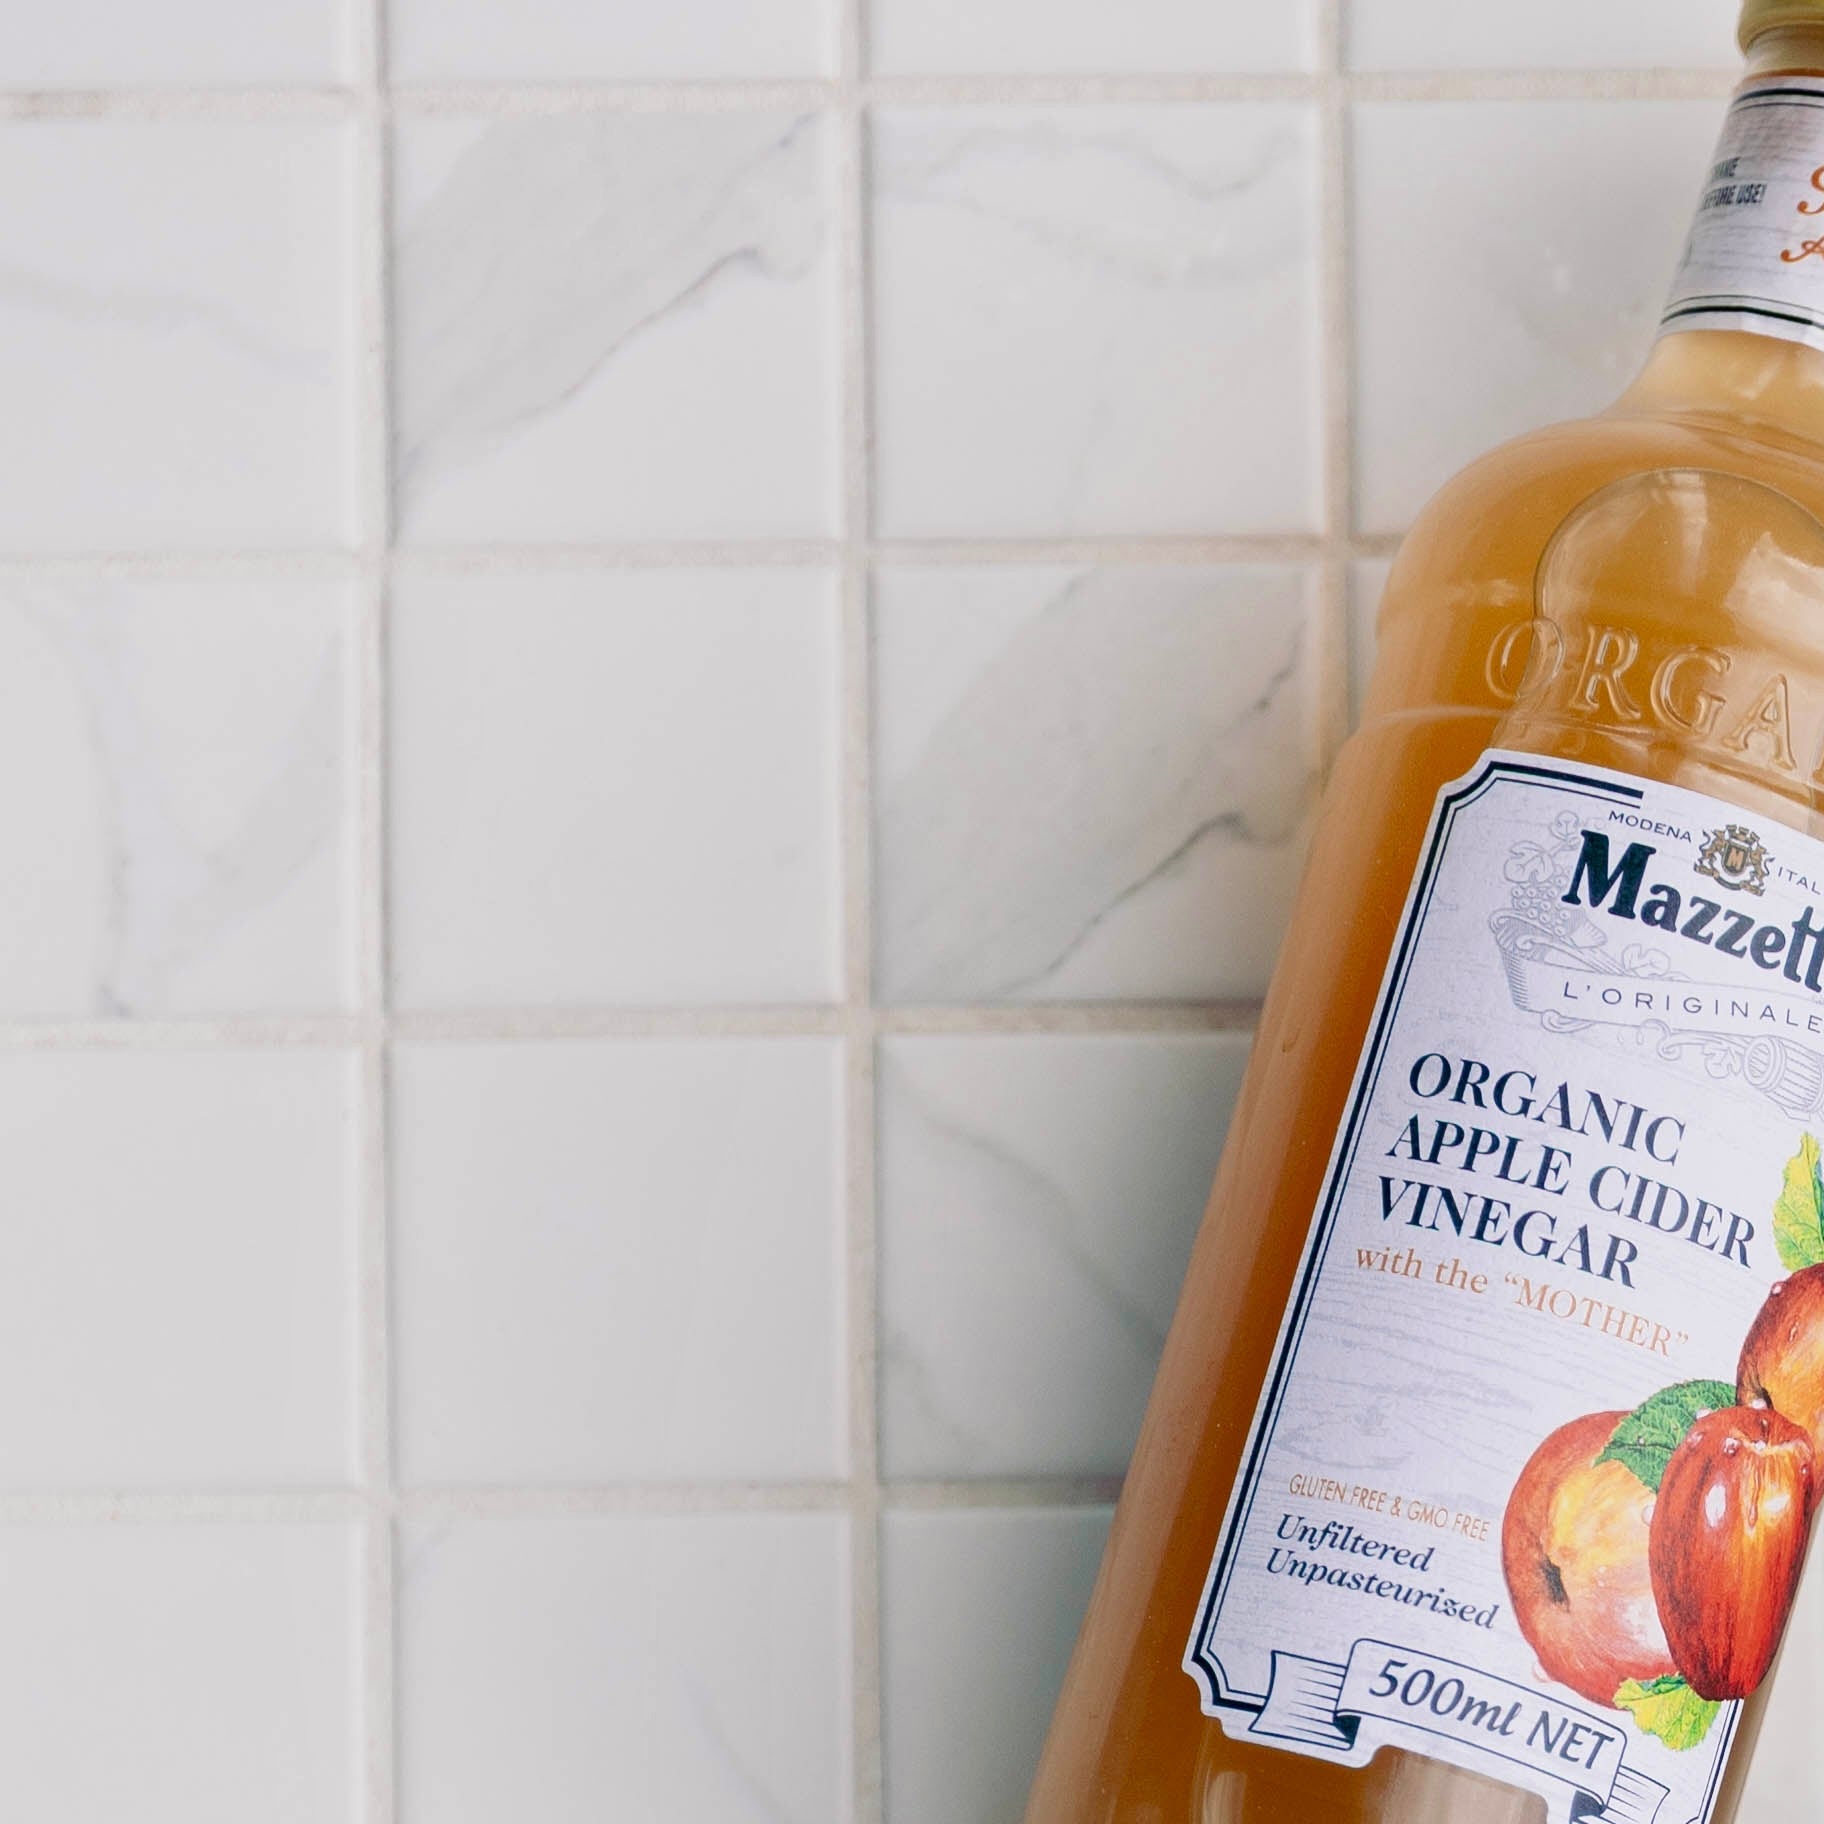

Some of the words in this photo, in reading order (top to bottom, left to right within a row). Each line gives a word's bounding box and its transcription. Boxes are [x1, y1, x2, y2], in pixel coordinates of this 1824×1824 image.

[1608, 809, 1693, 844] MODENA
[1562, 979, 1824, 1035] L'ORIGINALE
[1408, 1052, 1687, 1167] ORGANIC
[1385, 1112, 1573, 1196] APPLE
[1588, 1164, 1757, 1269] CIDER
[1376, 1175, 1640, 1290] VINEGAR
[1355, 1245, 1424, 1281] with
[1434, 1260, 1489, 1295] the
[1275, 1512, 1436, 1573] Unfiltered
[1288, 1473, 1348, 1507] GLUTEN
[1351, 1485, 1388, 1515] FREE
[1389, 1495, 1402, 1518] &
[1407, 1500, 1450, 1530] GMO
[1453, 1512, 1491, 1543] FREE
[1368, 1660, 1521, 1737] 500ml
[1526, 1711, 1614, 1771] NET
